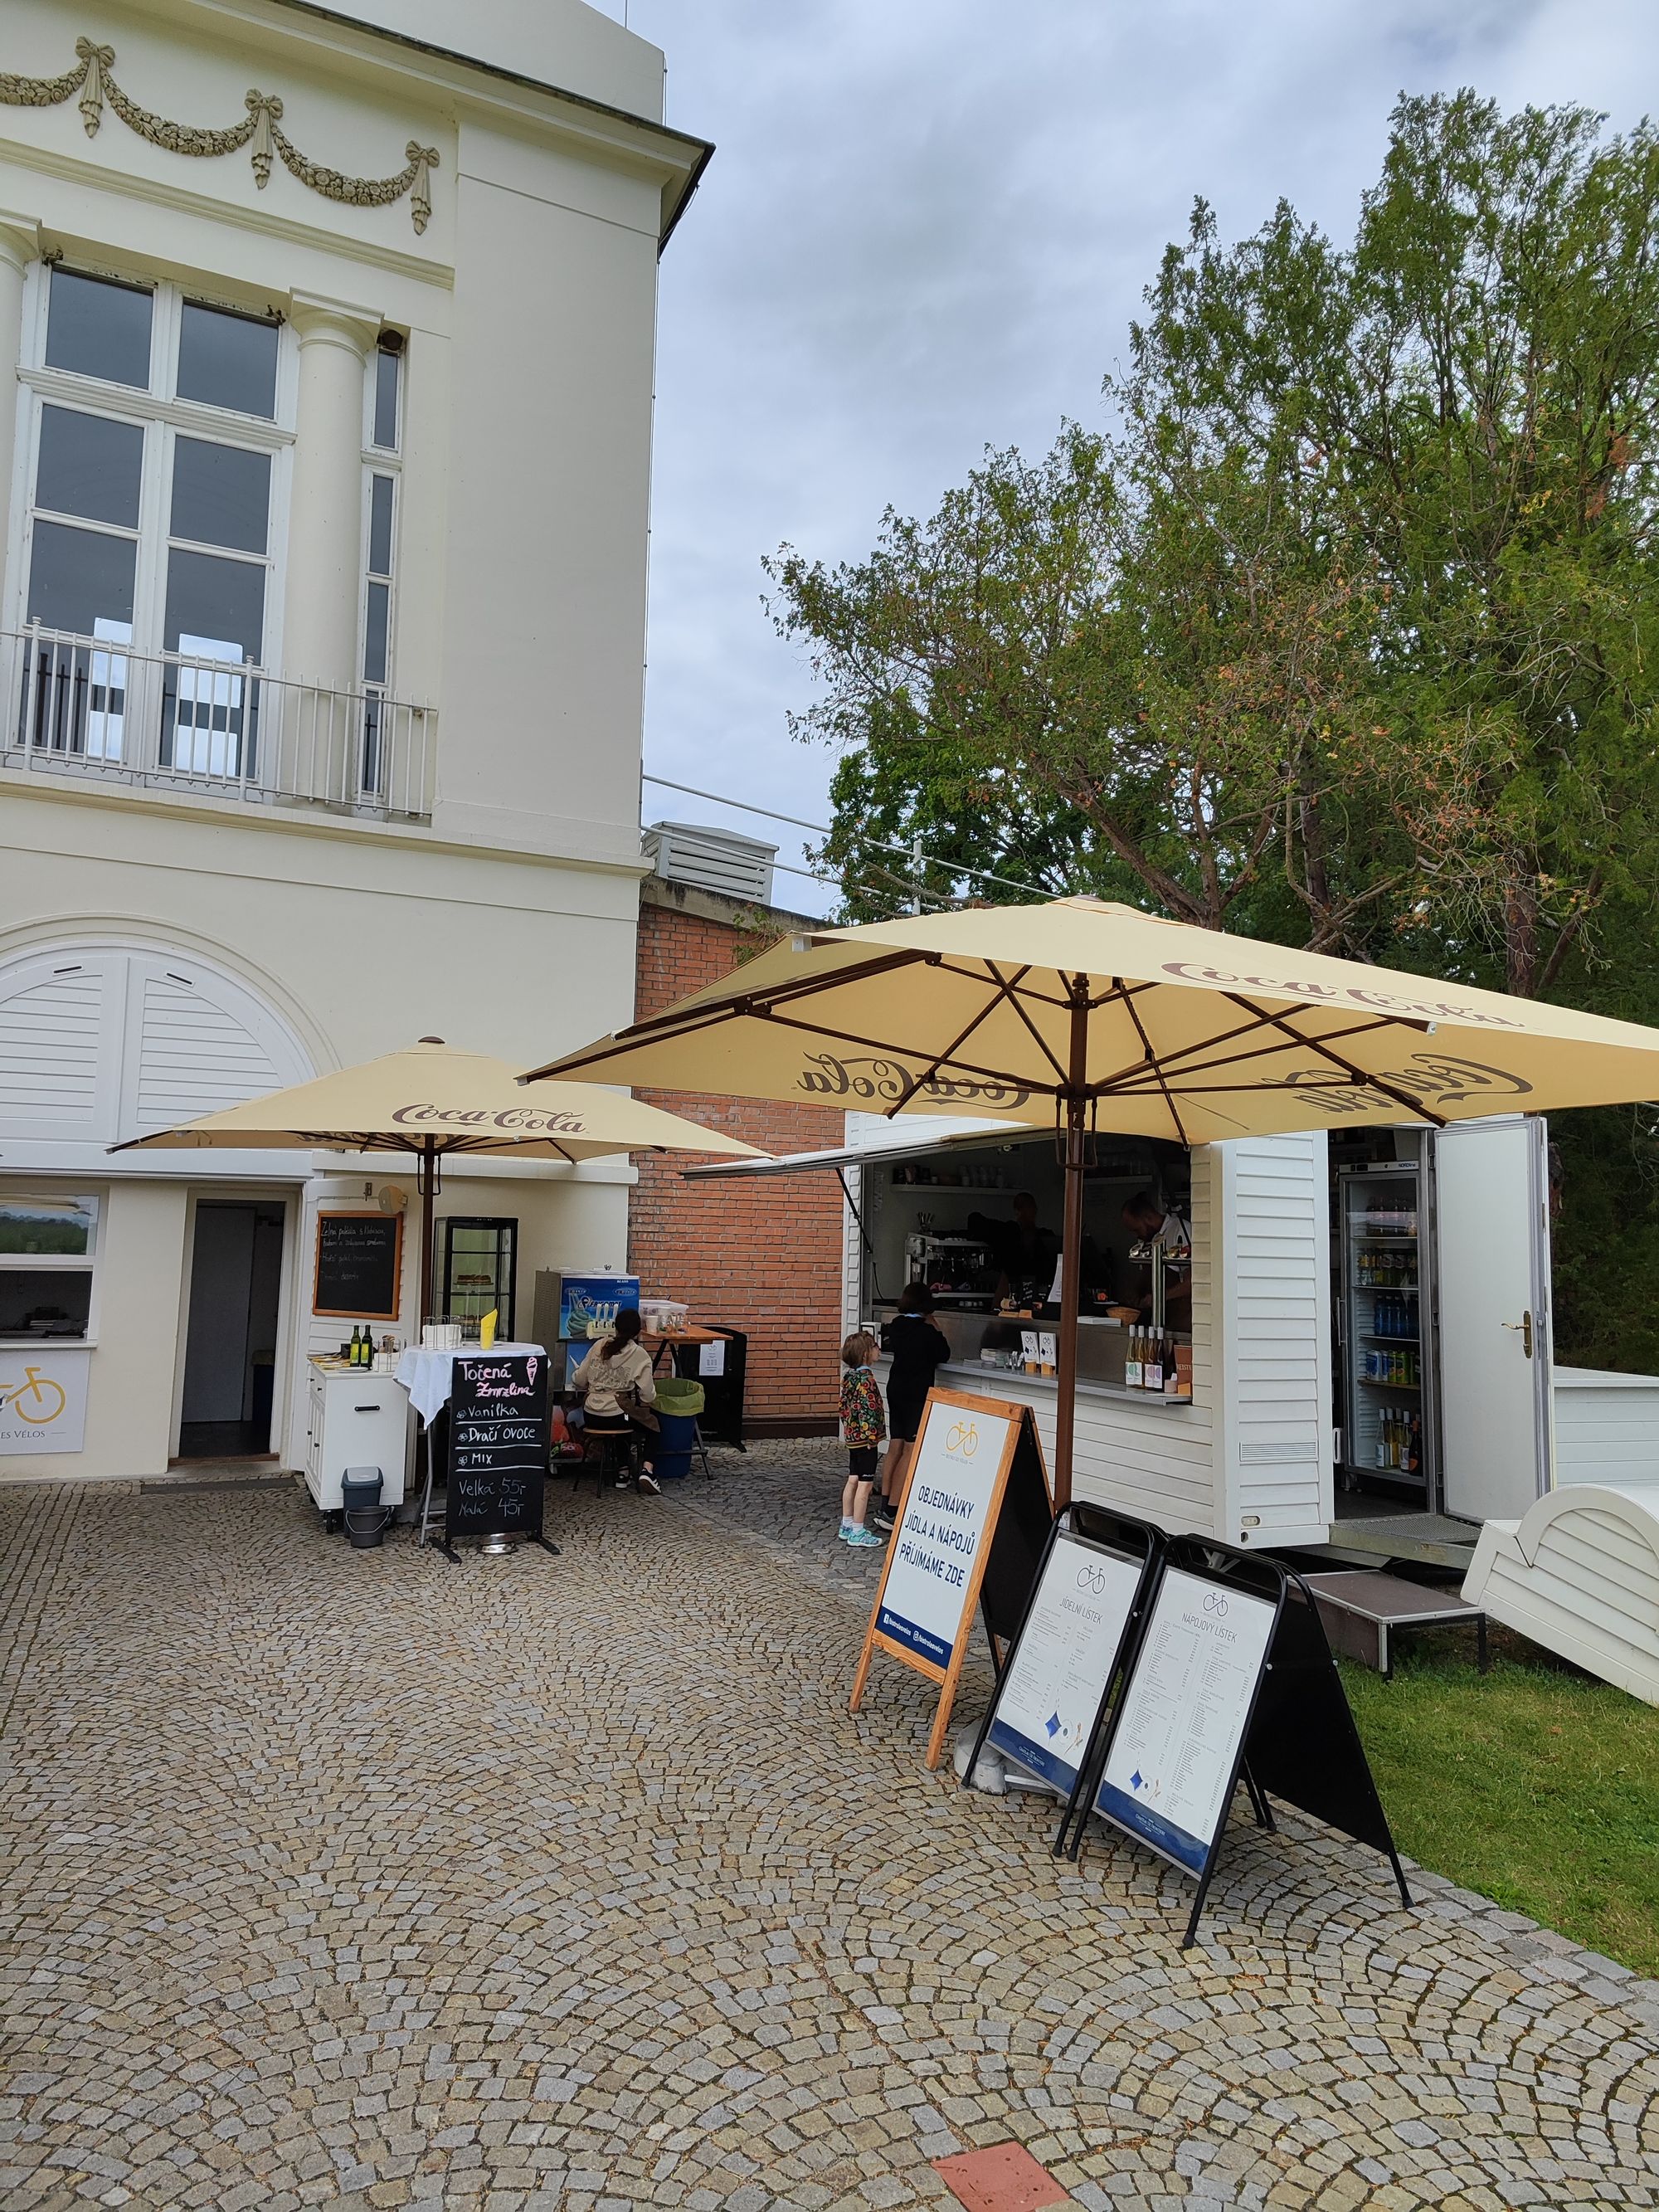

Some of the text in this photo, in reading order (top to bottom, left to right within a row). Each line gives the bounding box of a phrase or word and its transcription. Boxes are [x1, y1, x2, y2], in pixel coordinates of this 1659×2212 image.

[457, 1361, 512, 1381] Točená
[468, 1403, 518, 1417] Vanilka
[14, 1430, 46, 1439] VÉLOS
[471, 1453, 493, 1464] MIX
[459, 1478, 496, 1496] Velká
[917, 1485, 975, 1520] OBJEDNÁVKY
[904, 1509, 975, 1556] JÍDLA A NÁPOJŮ
[898, 1540, 966, 1588] PŘÍJÍMÁME ZDE
[1059, 1596, 1103, 1625] JÍDELNÍ LÍSTEK
[1181, 1612, 1238, 1644] NÁPOJOVÝ LÍSTEK
